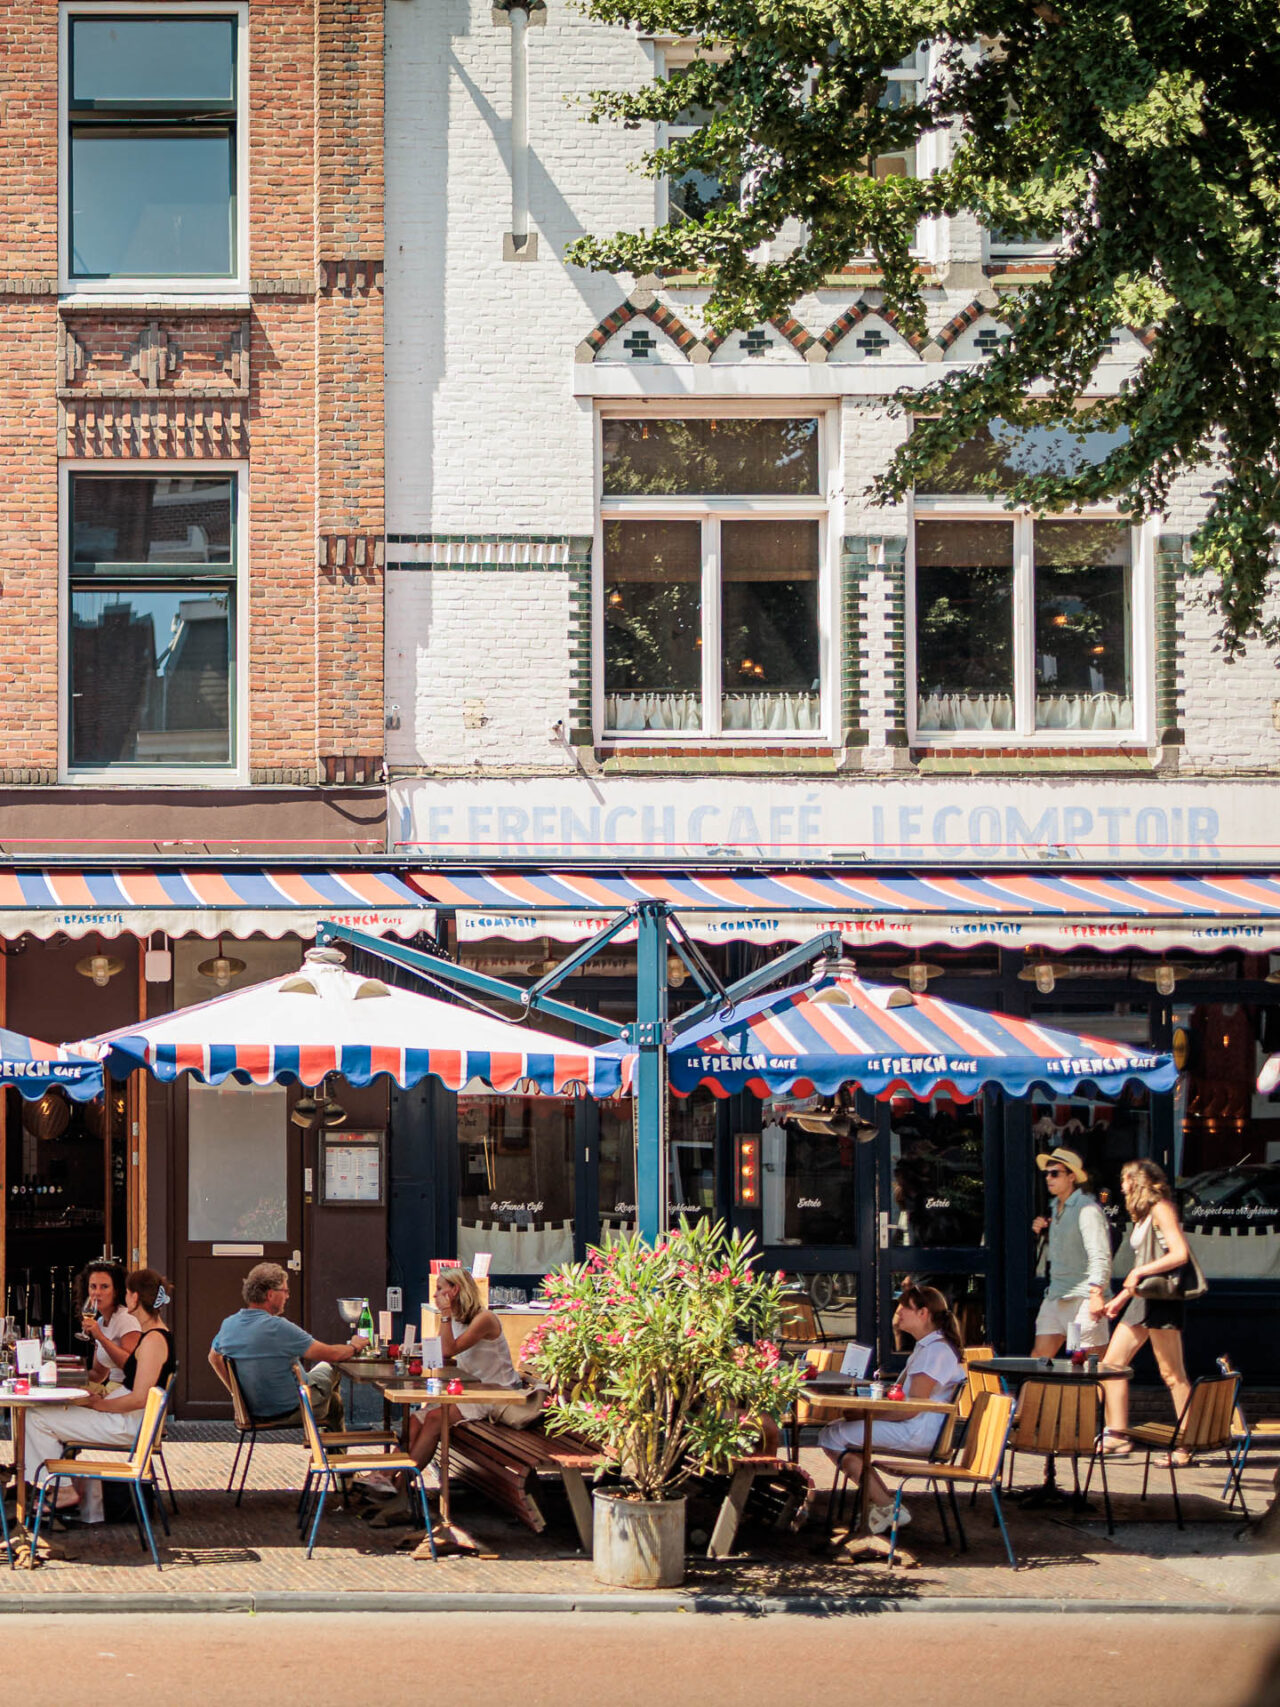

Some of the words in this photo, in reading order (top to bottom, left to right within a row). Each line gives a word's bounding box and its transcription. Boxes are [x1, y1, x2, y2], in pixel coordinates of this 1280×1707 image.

[468, 805, 675, 856] FRENCH
[687, 792, 822, 856] CAFÉ
[872, 805, 924, 858] LE
[932, 804, 1221, 859] COMPTOIR
[64, 914, 125, 925] BRASSERIE
[477, 916, 537, 929] COMPTOIR
[720, 918, 779, 932] COMPTOIR
[828, 918, 885, 933] FRENCH
[963, 921, 1022, 935] COMPTOIR
[1071, 922, 1128, 937] FRENCH
[1205, 925, 1265, 938] COMPTOIR
[687, 1058, 700, 1068] LE
[701, 1054, 767, 1073] FRENCH
[867, 1060, 880, 1070] LE
[881, 1055, 947, 1075] FRENCH
[1046, 1061, 1060, 1072] LE
[1060, 1057, 1128, 1076] FRENCH
[499, 1201, 525, 1211] French
[526, 1201, 545, 1213] Café
[796, 1197, 821, 1209] Entrée
[925, 1197, 951, 1209] Entrée
